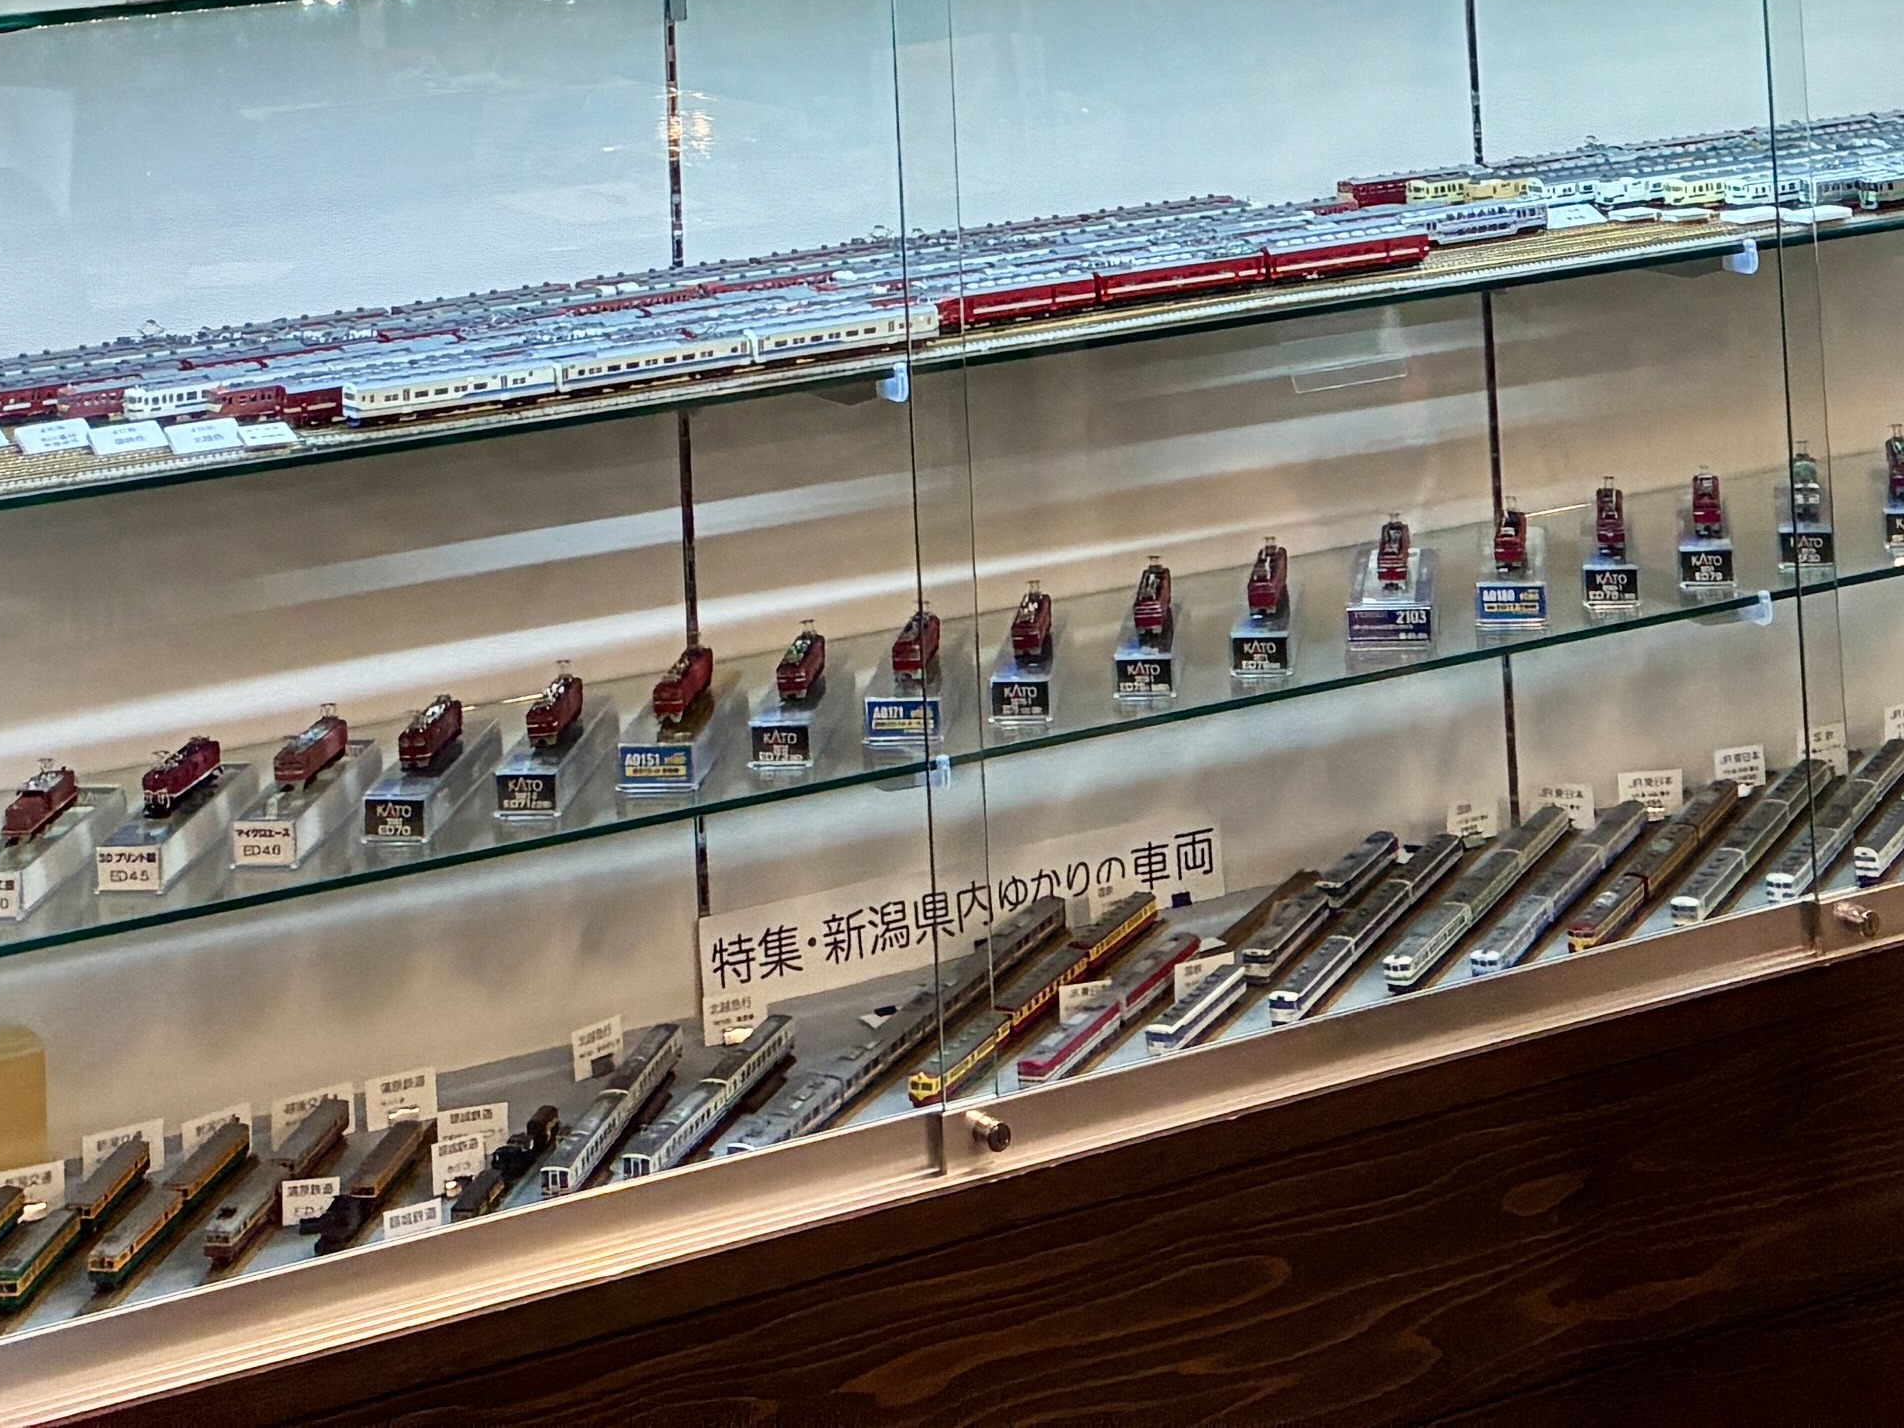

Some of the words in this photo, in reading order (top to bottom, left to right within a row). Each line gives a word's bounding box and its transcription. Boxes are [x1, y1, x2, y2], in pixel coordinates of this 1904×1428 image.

[1596, 572, 1628, 585] KATO
[1127, 663, 1160, 676] KATO
[1004, 685, 1038, 698] KATO
[763, 729, 798, 744] KATO
[508, 778, 543, 792] KATO
[376, 801, 413, 818] KATO
[110, 870, 151, 882] ED45
[710, 828, 1214, 990] 特集・新潟県内ゆかりの車両
